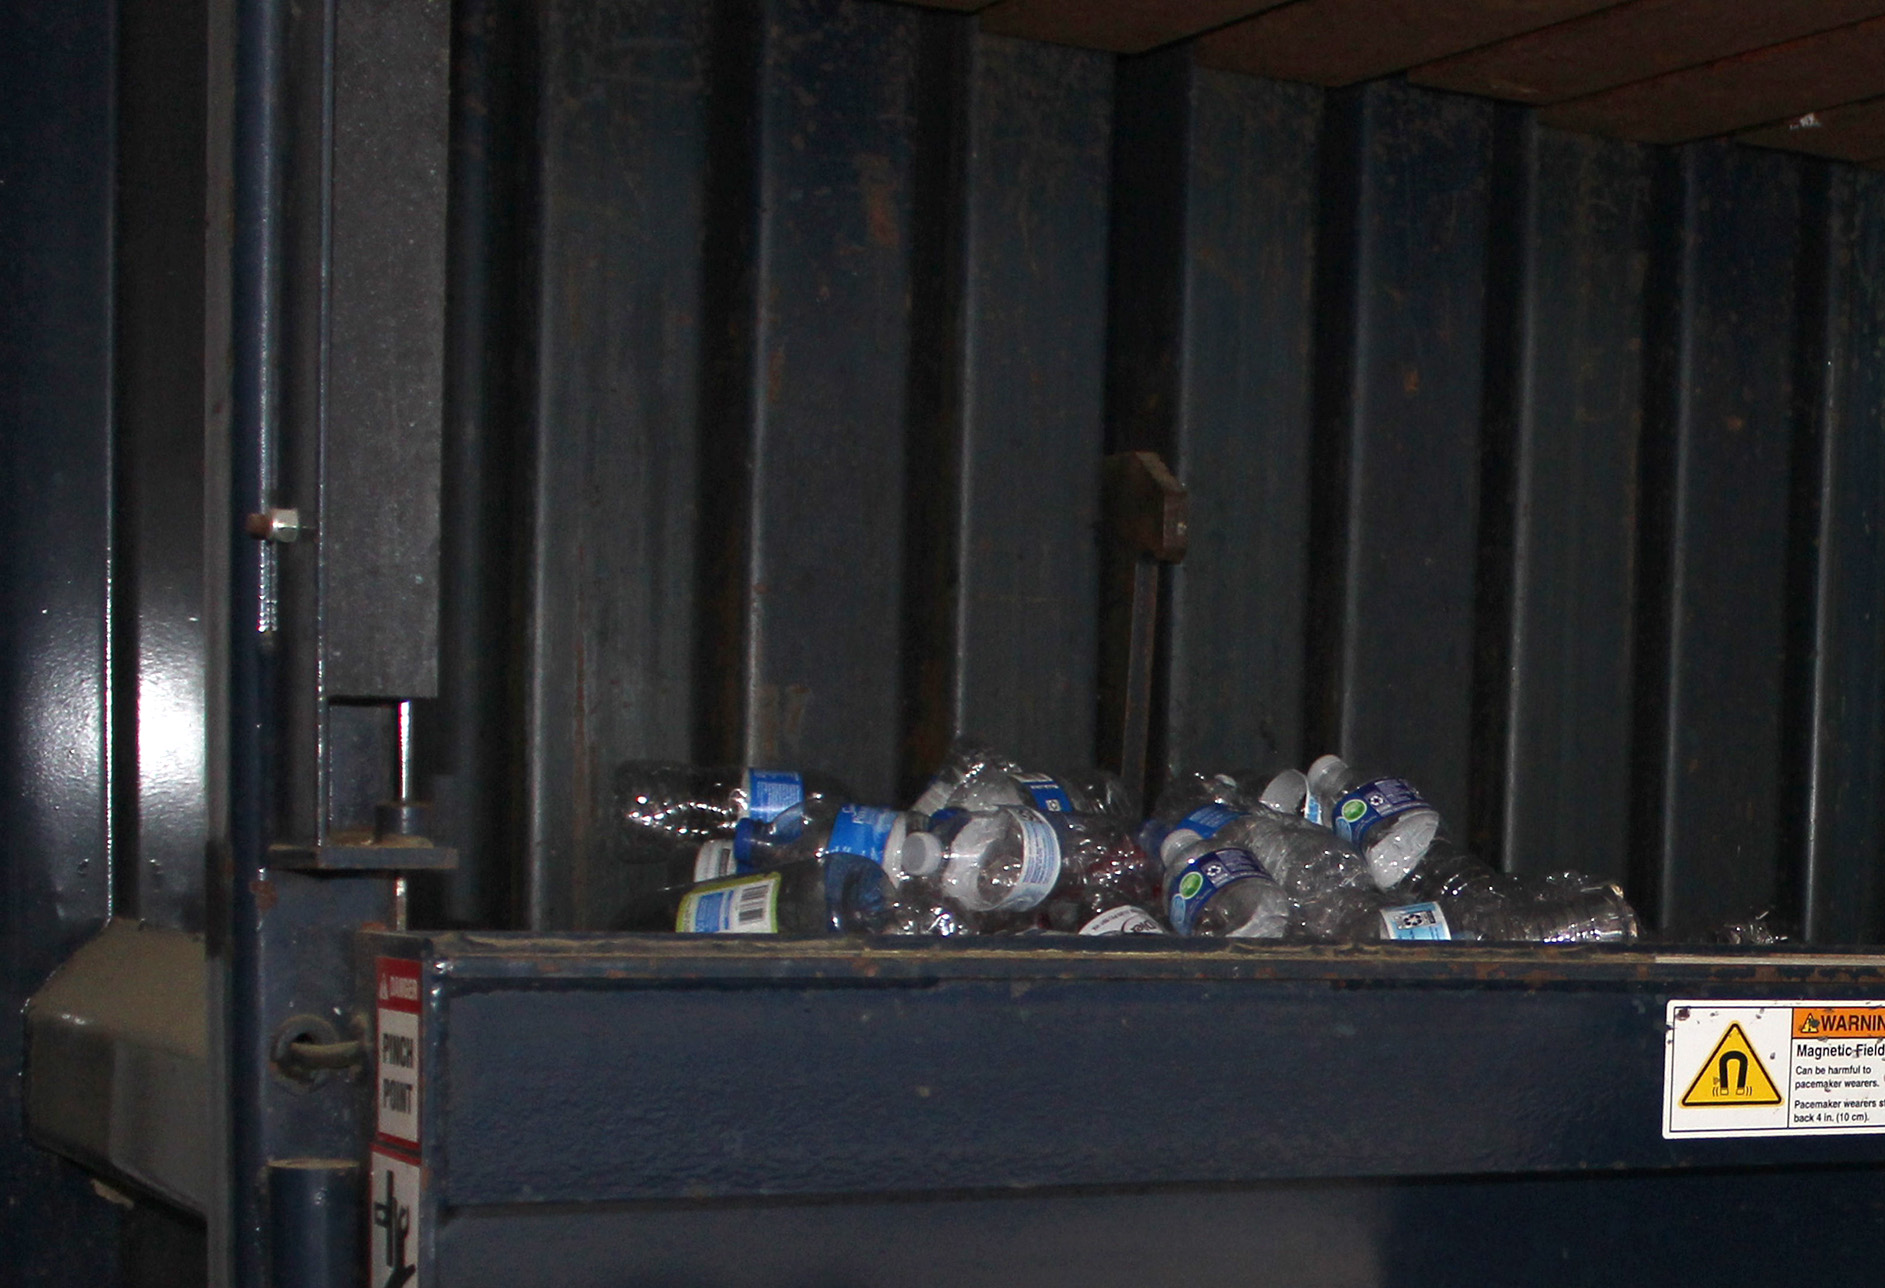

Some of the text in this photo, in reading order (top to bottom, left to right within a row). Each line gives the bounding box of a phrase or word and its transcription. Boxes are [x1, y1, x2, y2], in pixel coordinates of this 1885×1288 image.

[382, 1032, 414, 1069] PINCH
[1797, 1043, 1853, 1060] Magnetic
[1795, 1064, 1872, 1075] Can be harmful to
[1794, 1079, 1880, 1091] pacemaker wearers.
[382, 1077, 413, 1115] POINT
[1794, 1099, 1842, 1110] Pacemaker
[1844, 1100, 1877, 1109] wearers
[1793, 1112, 1870, 1123] back 4 in. (10 cm).
